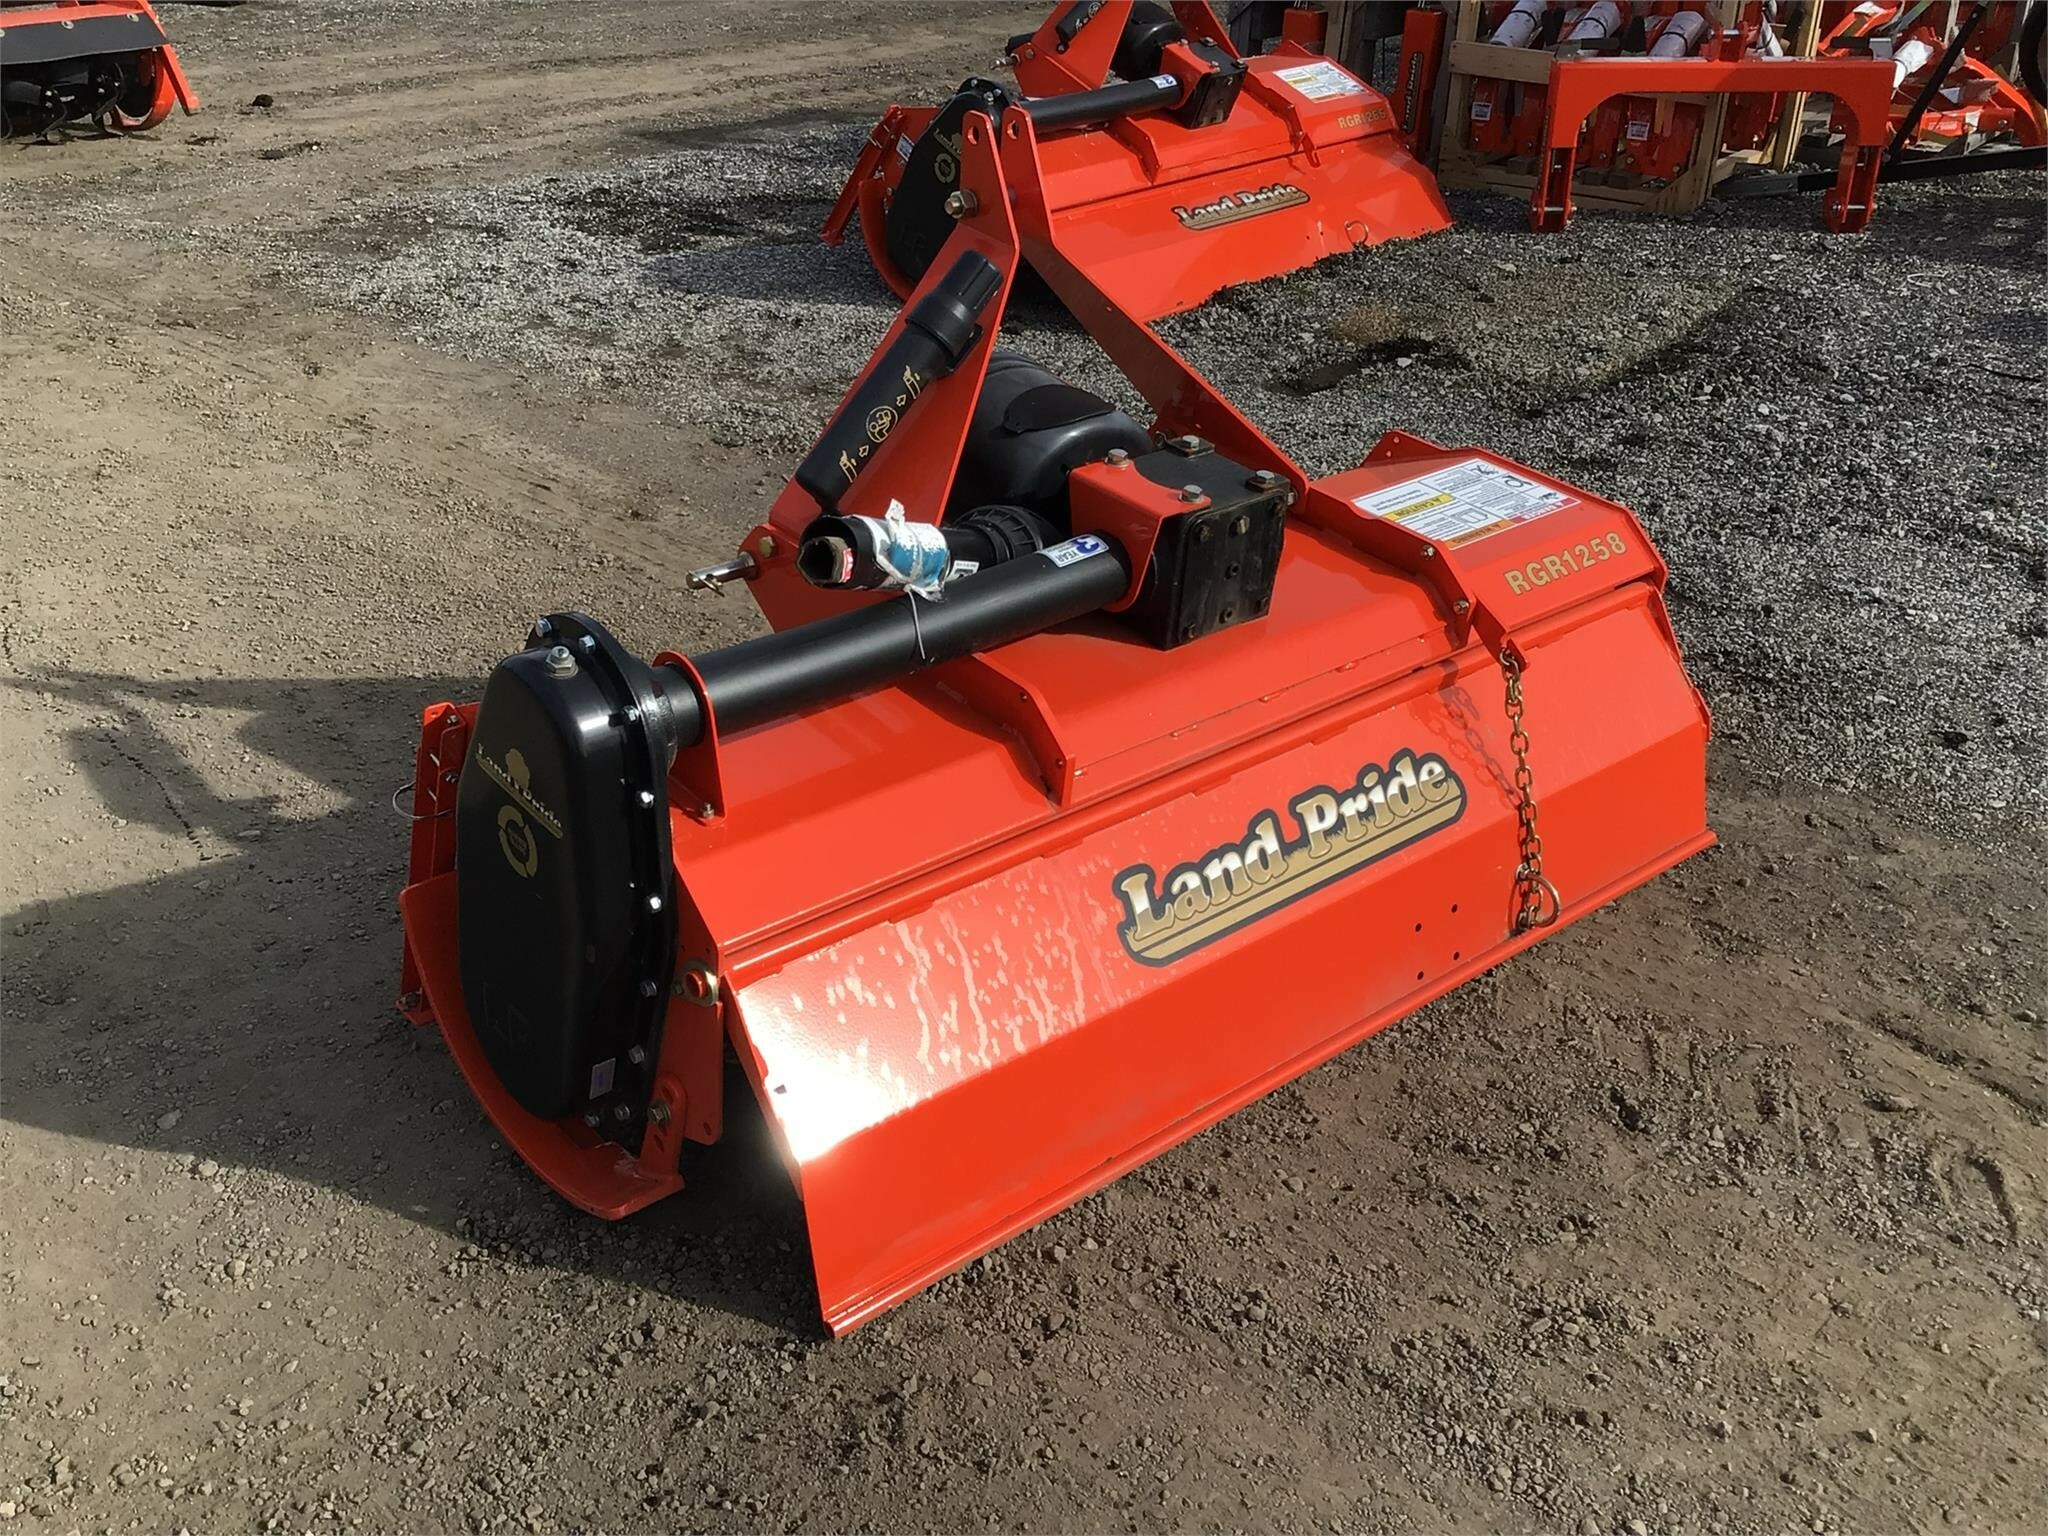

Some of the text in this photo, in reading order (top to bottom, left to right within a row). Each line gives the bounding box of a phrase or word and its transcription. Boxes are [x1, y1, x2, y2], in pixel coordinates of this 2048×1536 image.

[1174, 184, 1299, 222] Land Pride
[1394, 501, 1432, 518] CAUTION
[1055, 549, 1079, 562] YEAR
[1503, 532, 1626, 596] RGR1258
[1121, 755, 1450, 941] Land Pride
